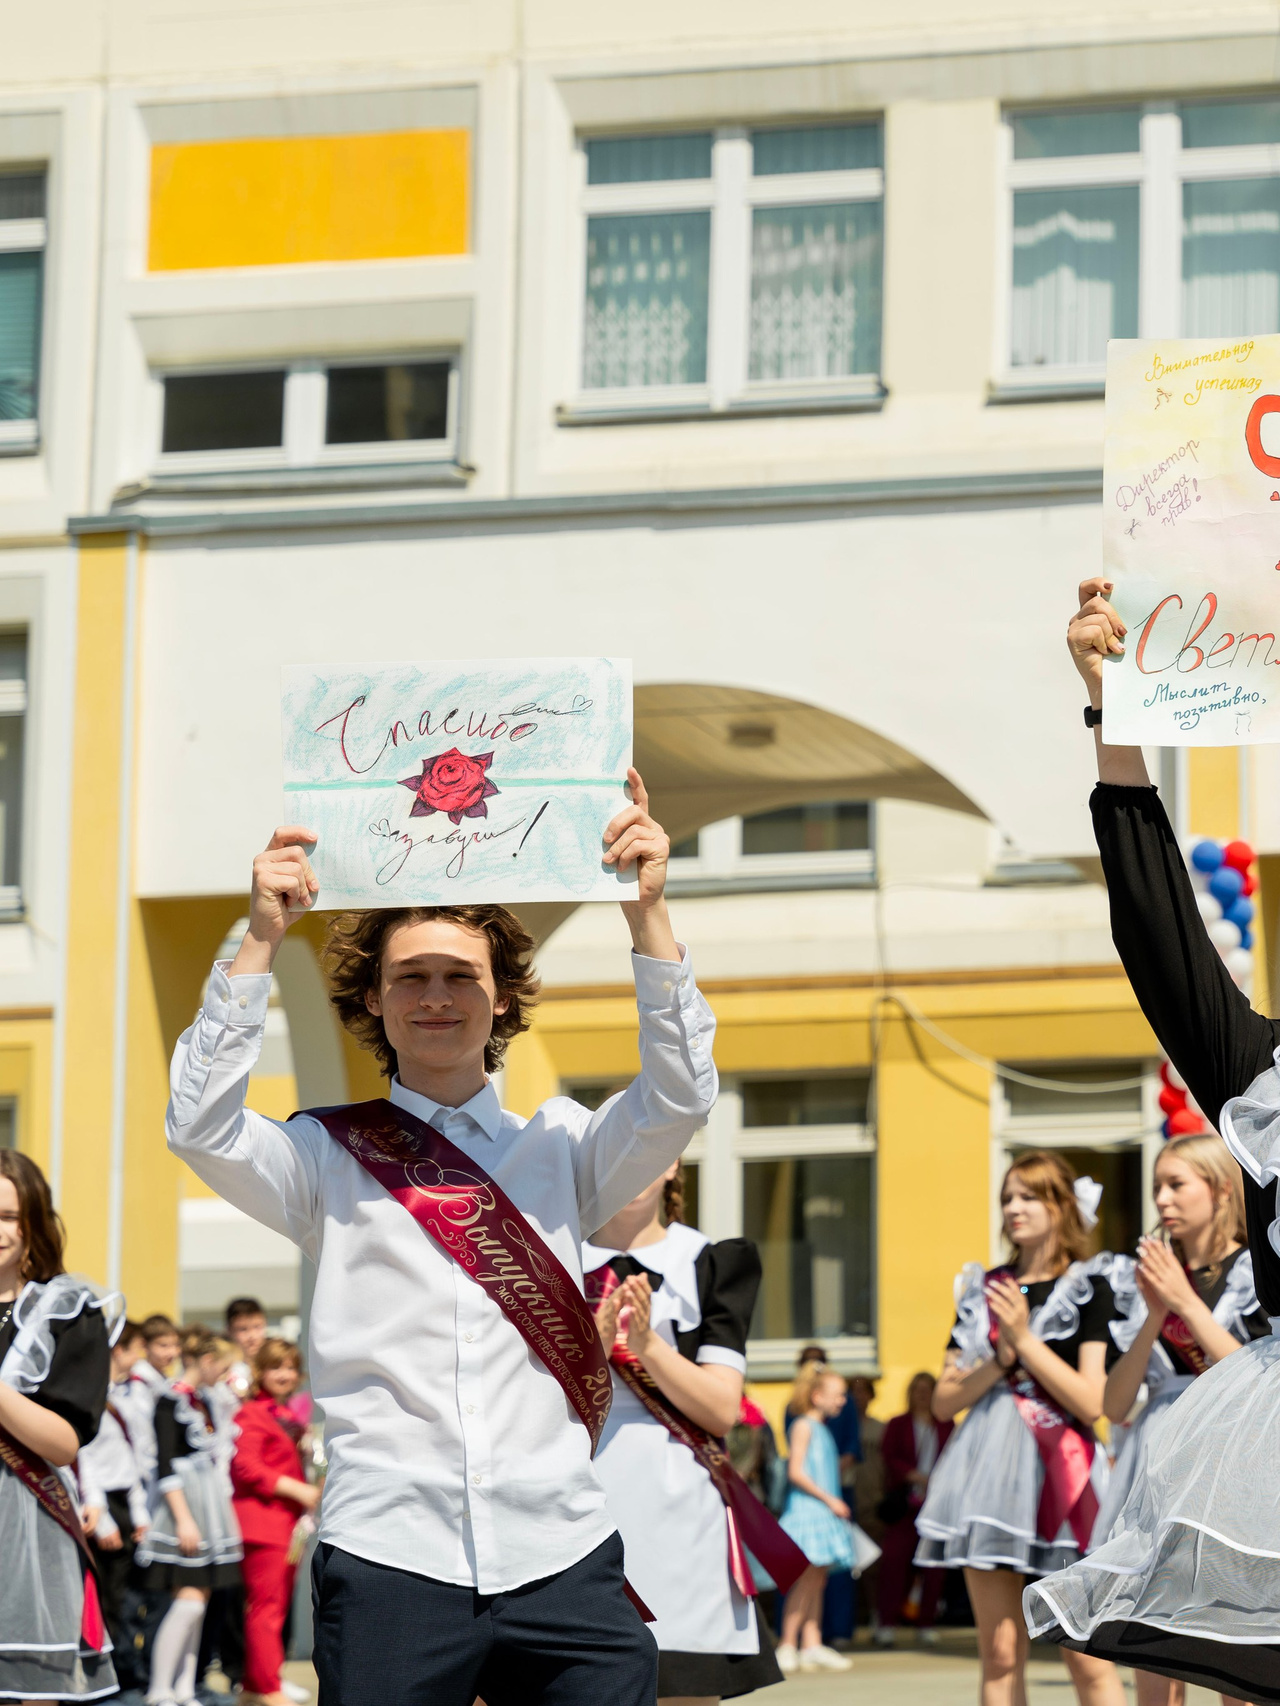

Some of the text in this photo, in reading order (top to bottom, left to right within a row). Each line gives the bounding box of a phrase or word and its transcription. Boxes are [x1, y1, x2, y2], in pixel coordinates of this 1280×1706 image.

[1145, 341, 1255, 382] Внимательная
[1184, 377, 1263, 405] успешная
[1115, 439, 1200, 512] Директор
[1145, 474, 1191, 516] всегда
[1161, 477, 1202, 527] прав!
[1143, 682, 1231, 708] Мыслит
[1173, 686, 1267, 731] позитивно,
[315, 695, 570, 774] Спасибо
[375, 800, 550, 886] завучи!
[404, 1157, 585, 1363] Выпускник
[495, 1285, 524, 1312] МОУ
[515, 1311, 543, 1340] СОШ
[533, 1333, 591, 1417] ПЕРСПЕКТИВА
